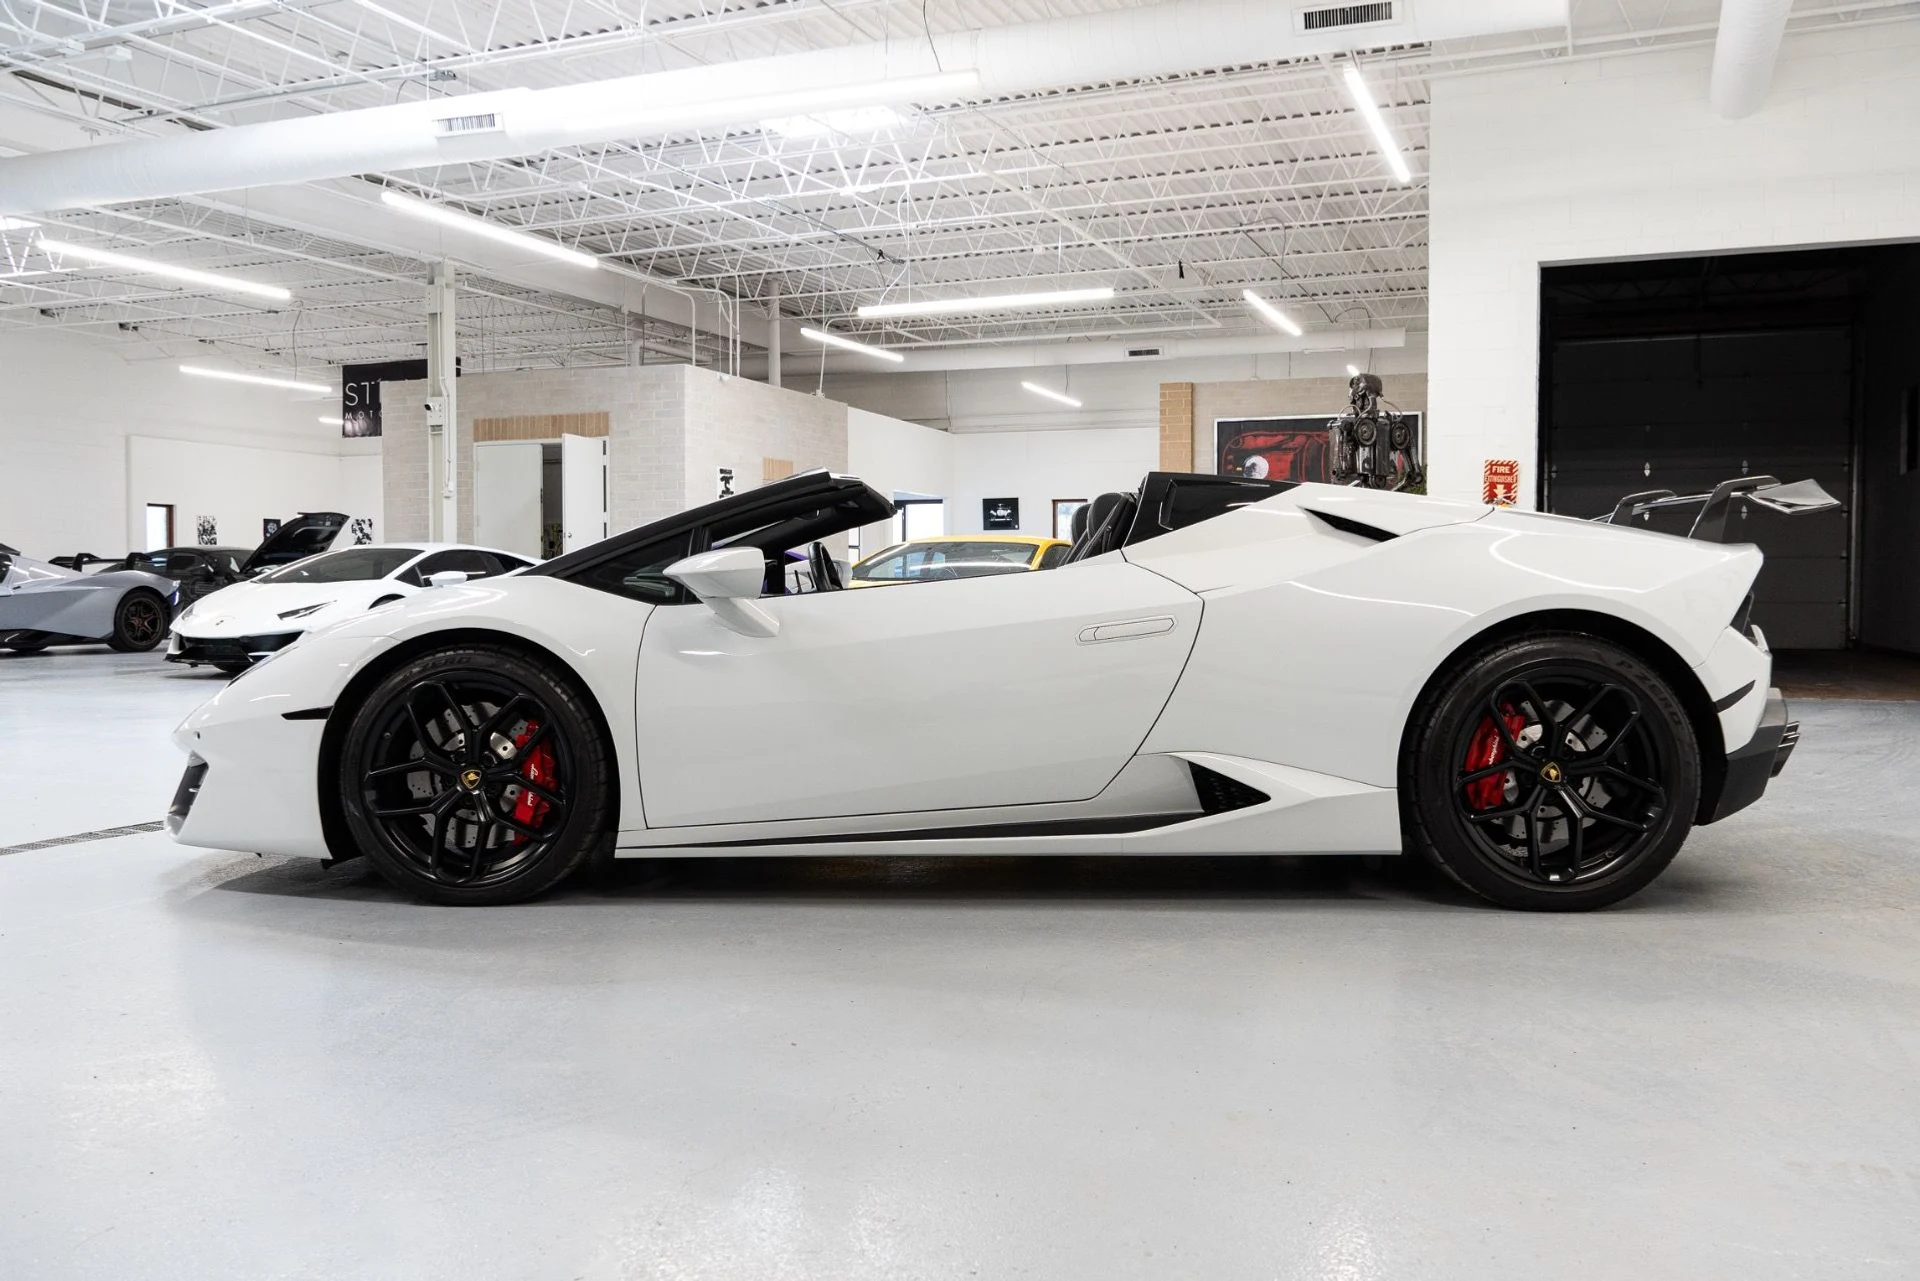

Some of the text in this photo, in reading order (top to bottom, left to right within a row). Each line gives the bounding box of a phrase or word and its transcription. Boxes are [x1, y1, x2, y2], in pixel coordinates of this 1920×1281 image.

[345, 379, 381, 406] ST
[1492, 466, 1511, 474] FIRE
[1634, 671, 1683, 726] ZERO
